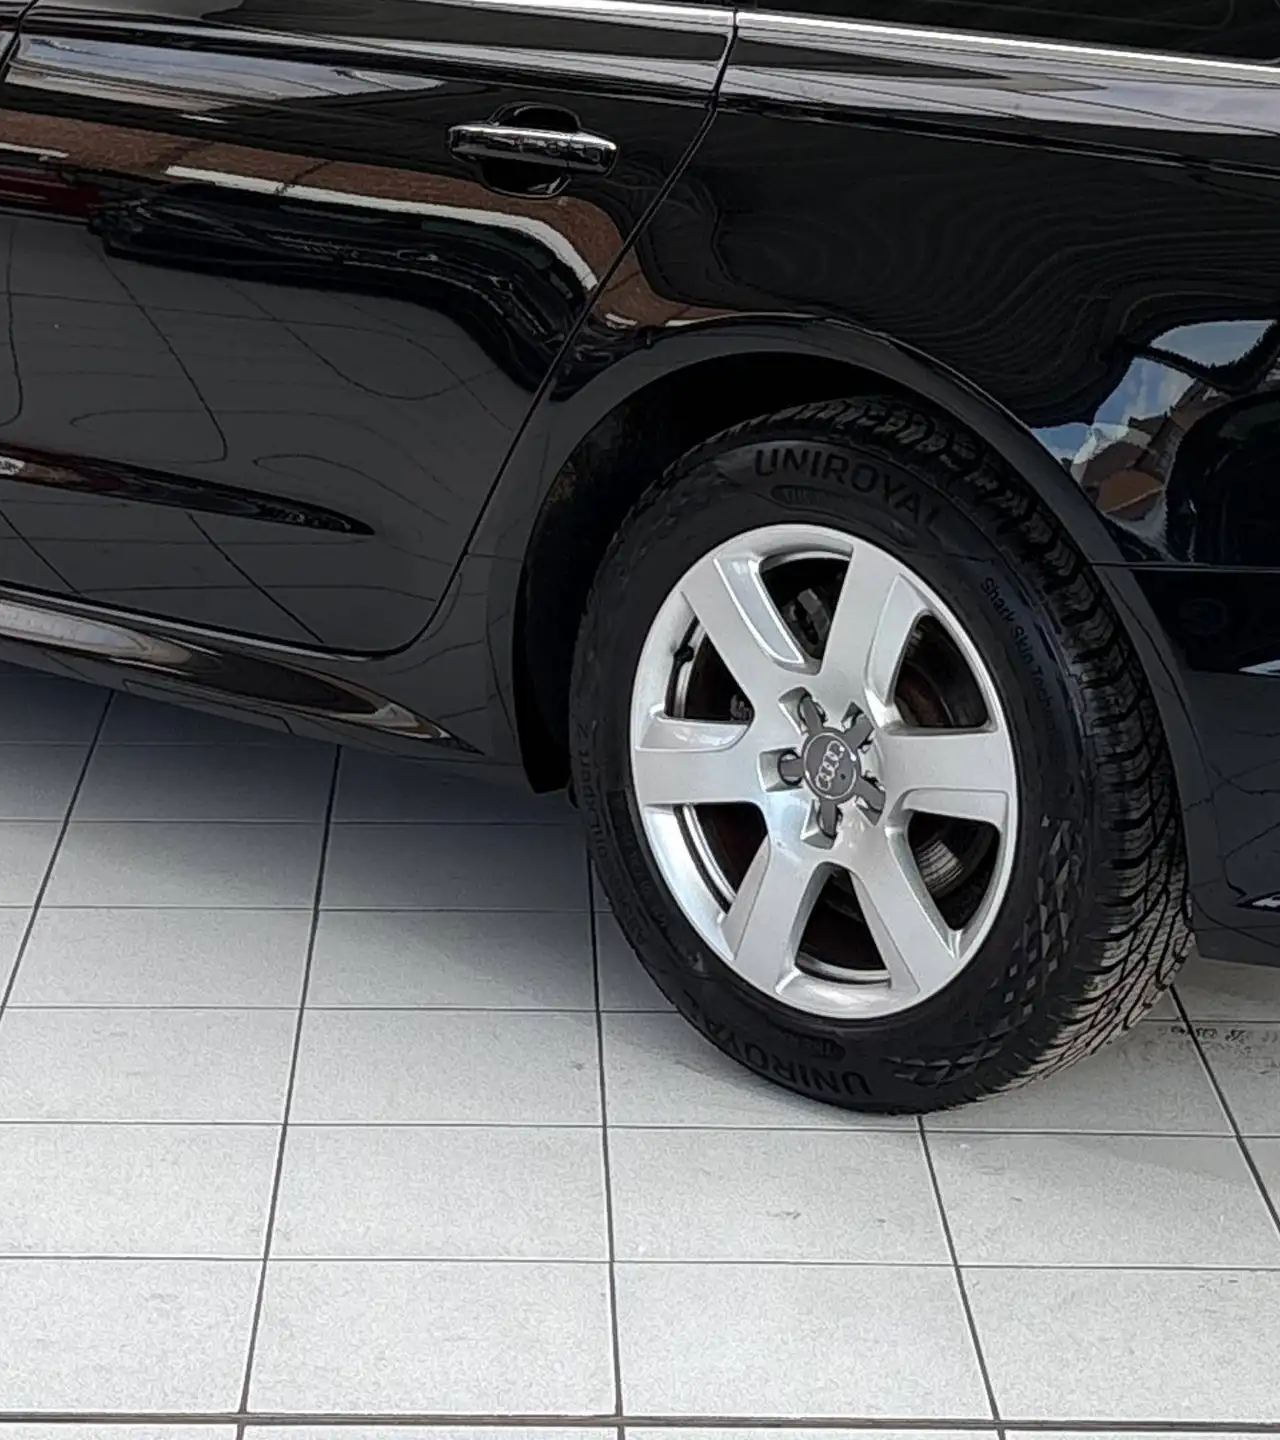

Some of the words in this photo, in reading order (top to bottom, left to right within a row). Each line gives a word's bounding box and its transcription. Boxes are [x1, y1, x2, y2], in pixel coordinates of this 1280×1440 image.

[755, 448, 941, 540] UNIROYAL
[980, 577, 1017, 624] Shark
[1013, 626, 1035, 666] Skin
